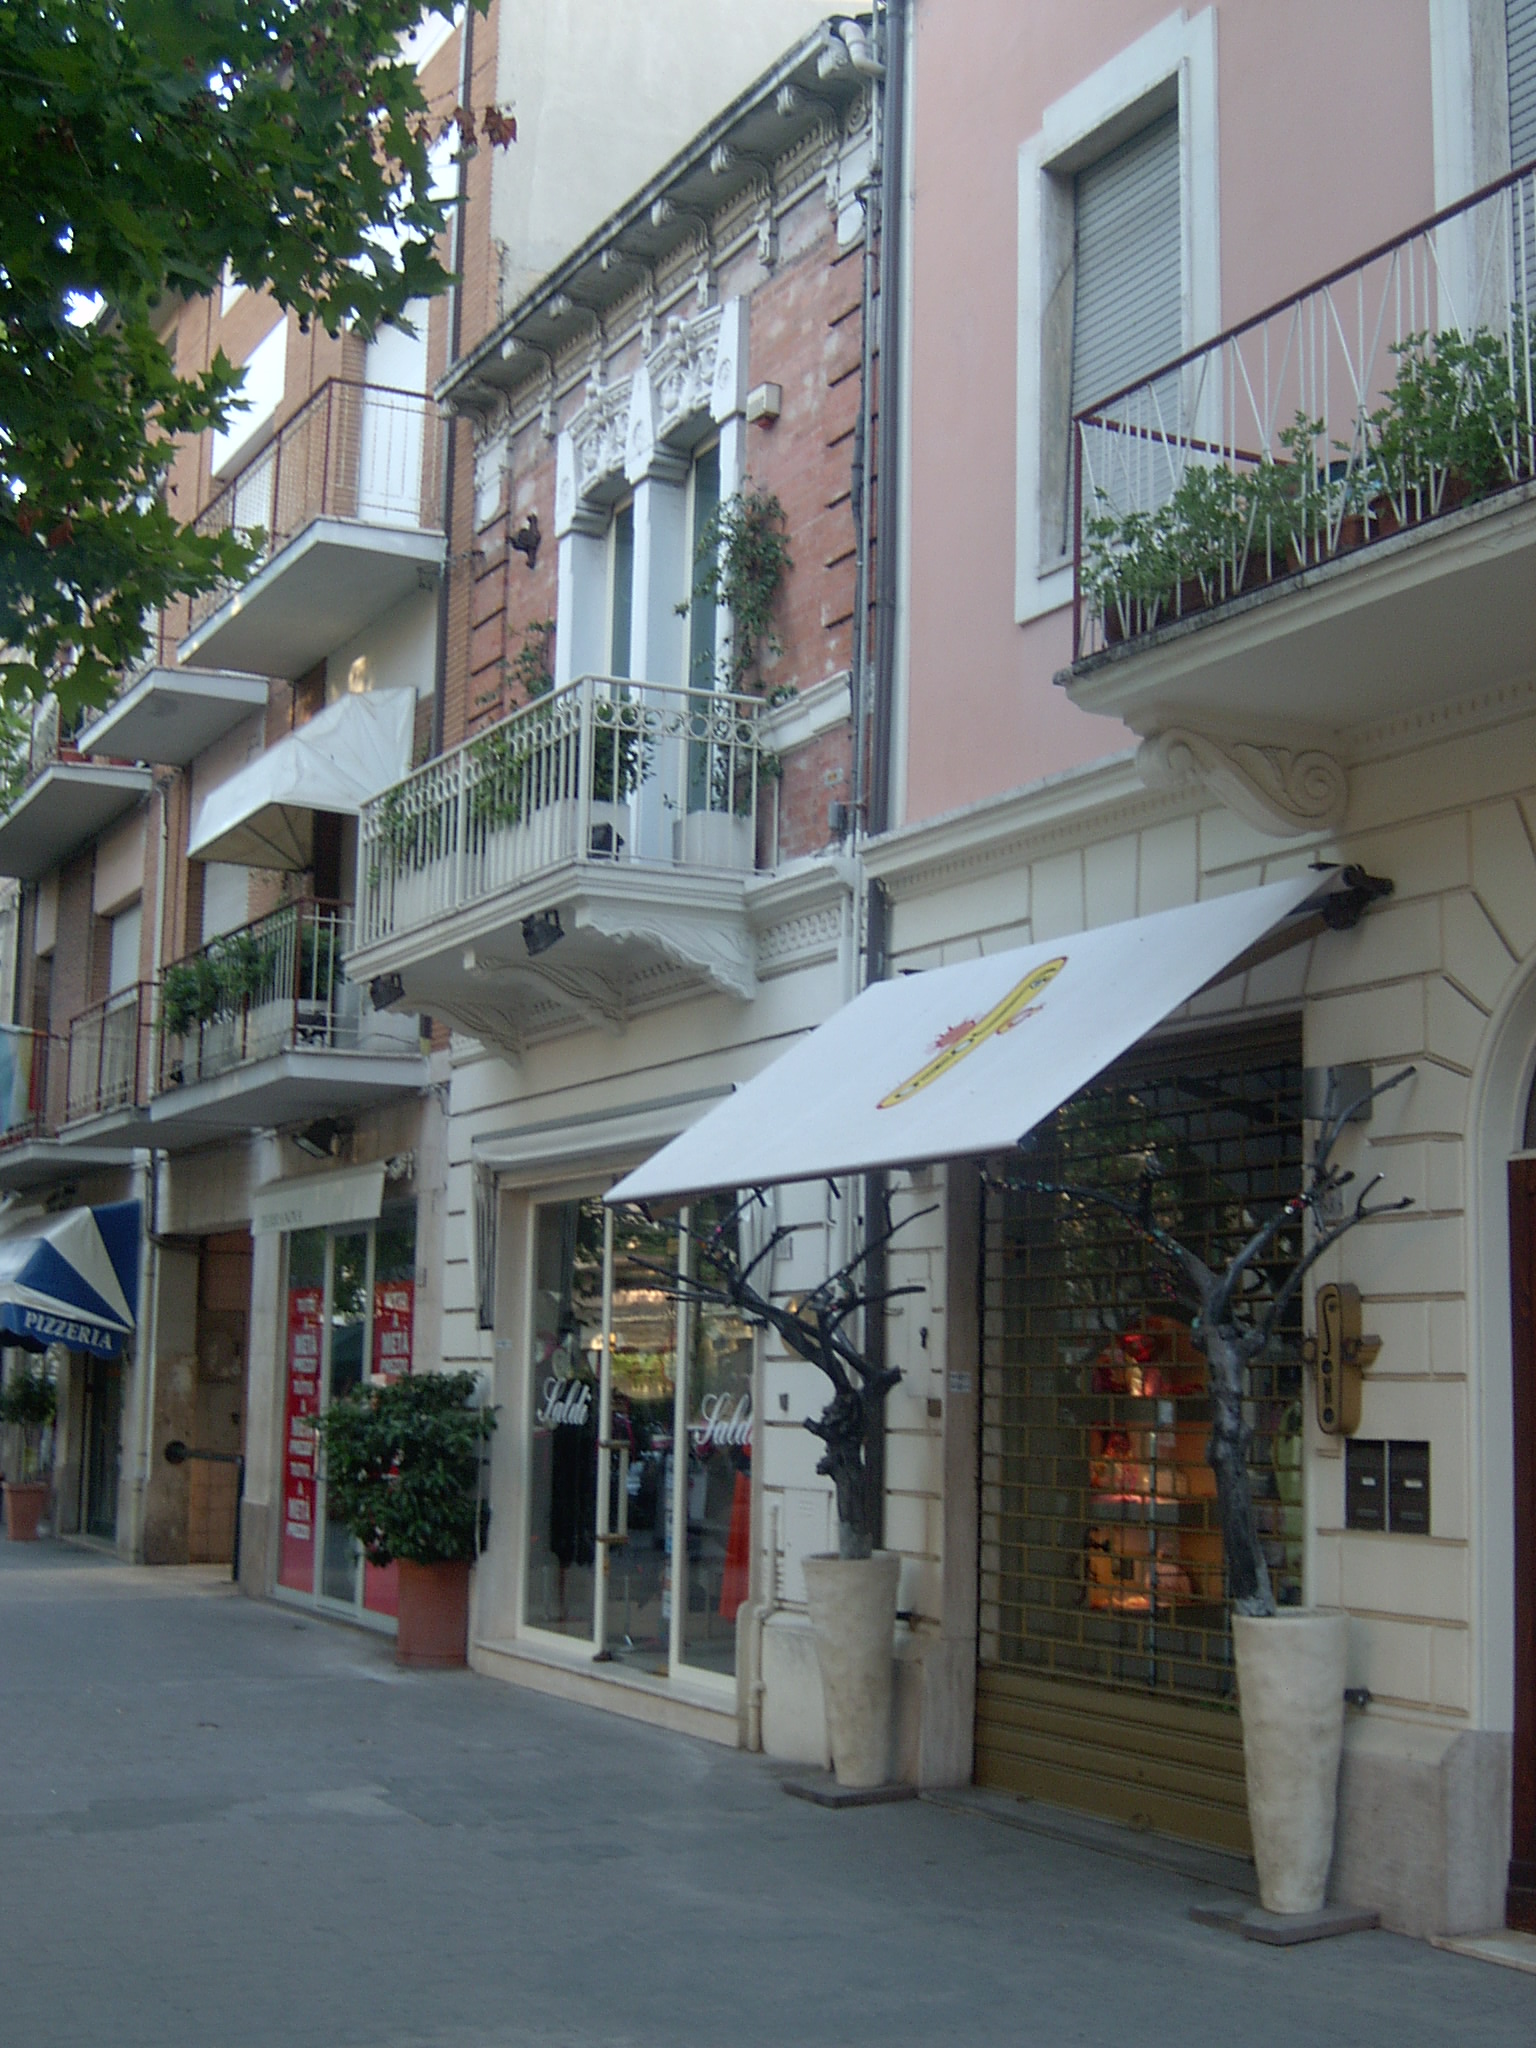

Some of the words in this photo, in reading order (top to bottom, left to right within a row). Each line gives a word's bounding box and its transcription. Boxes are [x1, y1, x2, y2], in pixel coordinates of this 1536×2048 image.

[24, 1310, 113, 1350] PIZZERIA
[537, 1376, 592, 1426] Saldi
[694, 1392, 753, 1446] Sald
